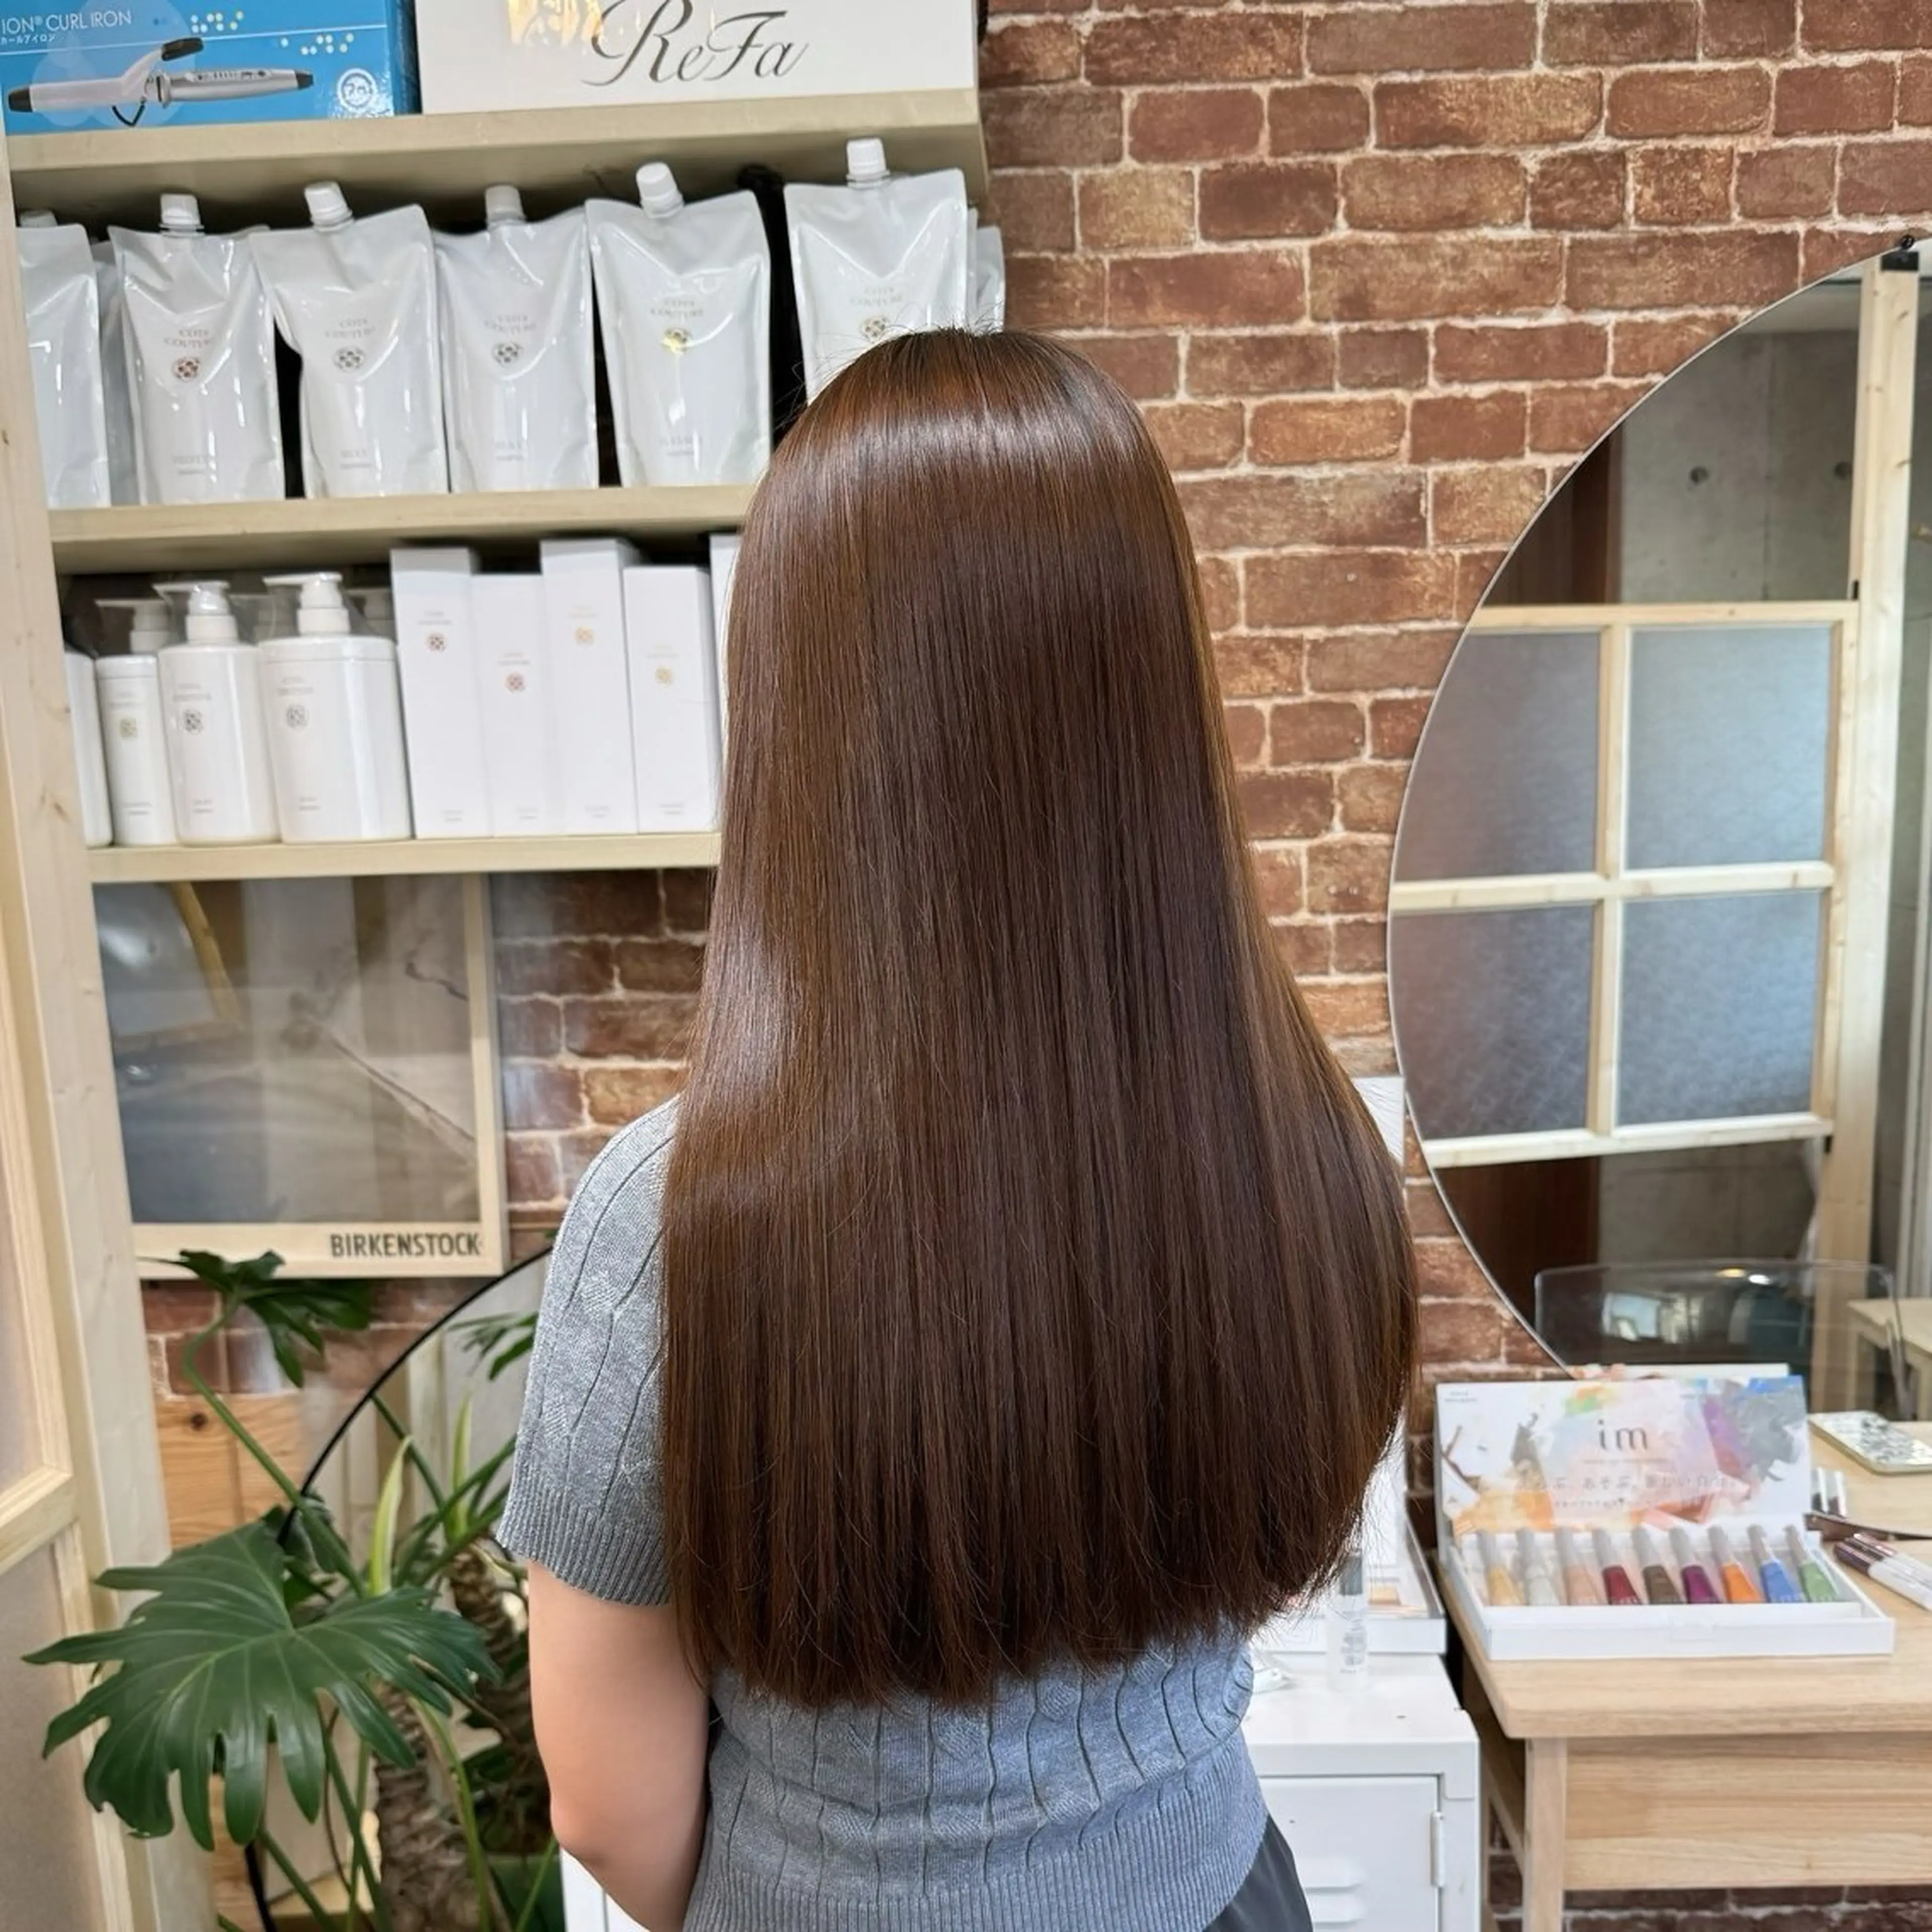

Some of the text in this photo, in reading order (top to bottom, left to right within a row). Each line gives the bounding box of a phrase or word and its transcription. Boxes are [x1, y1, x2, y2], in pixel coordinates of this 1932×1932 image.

[45, 13, 88, 32] CURL
[90, 9, 132, 28] IRON
[581, 0, 810, 86] ReFa
[330, 1232, 481, 1257] BIRKENSTOCK
[1597, 1418, 1650, 1452] im
